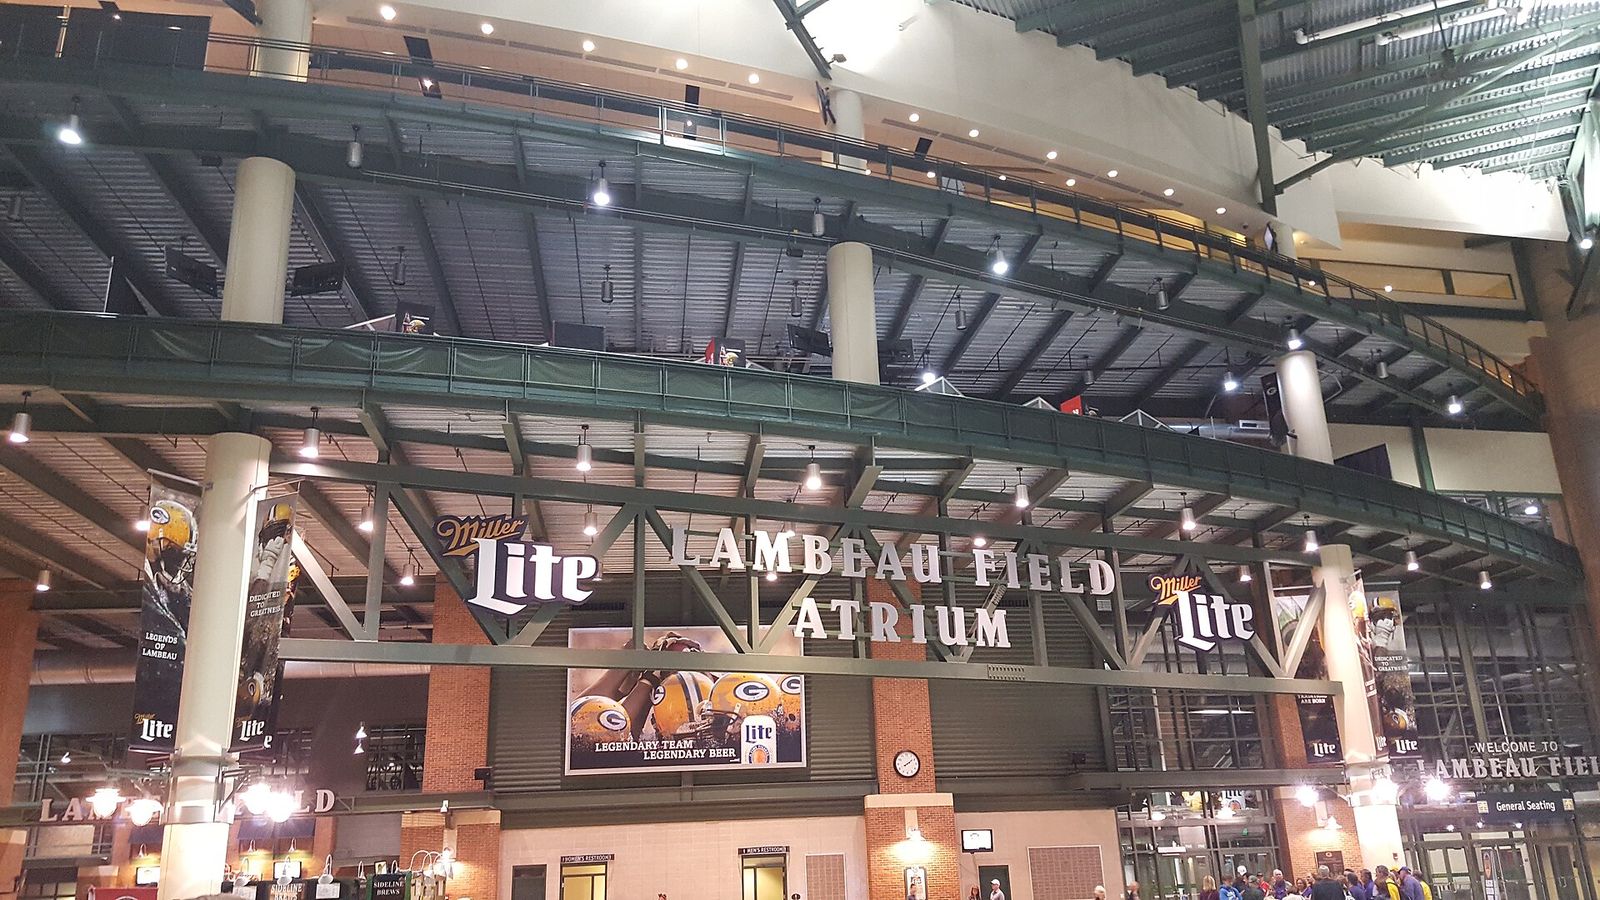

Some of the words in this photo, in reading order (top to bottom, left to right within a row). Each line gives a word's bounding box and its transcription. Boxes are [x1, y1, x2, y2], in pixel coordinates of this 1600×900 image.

[436, 518, 525, 557] Miller
[670, 524, 942, 584] LAMBEAU
[972, 548, 1116, 596] FIELD
[467, 537, 594, 615] Lite
[249, 590, 281, 603] DEDICATED
[1150, 576, 1203, 606] Miller
[256, 601, 265, 609] TO
[793, 597, 1012, 648] ATRIUM
[1174, 590, 1255, 651] Lite
[145, 632, 178, 645] LEGENDS
[142, 648, 178, 661] LAMBEAU
[154, 643, 166, 651] OF
[141, 719, 173, 742] Lite
[239, 721, 265, 742] Lite
[745, 725, 772, 744] Lite
[595, 742, 659, 752] LEGENDARY
[662, 740, 694, 749] TEAM
[1312, 742, 1336, 758] Lite
[1394, 739, 1418, 754] Lite
[1475, 742, 1537, 753] WELCOME
[1542, 740, 1559, 752] TO
[643, 750, 706, 761] LEGENDARY
[709, 748, 737, 758] BEER
[1496, 802, 1526, 812] General
[1526, 800, 1556, 812] Seating
